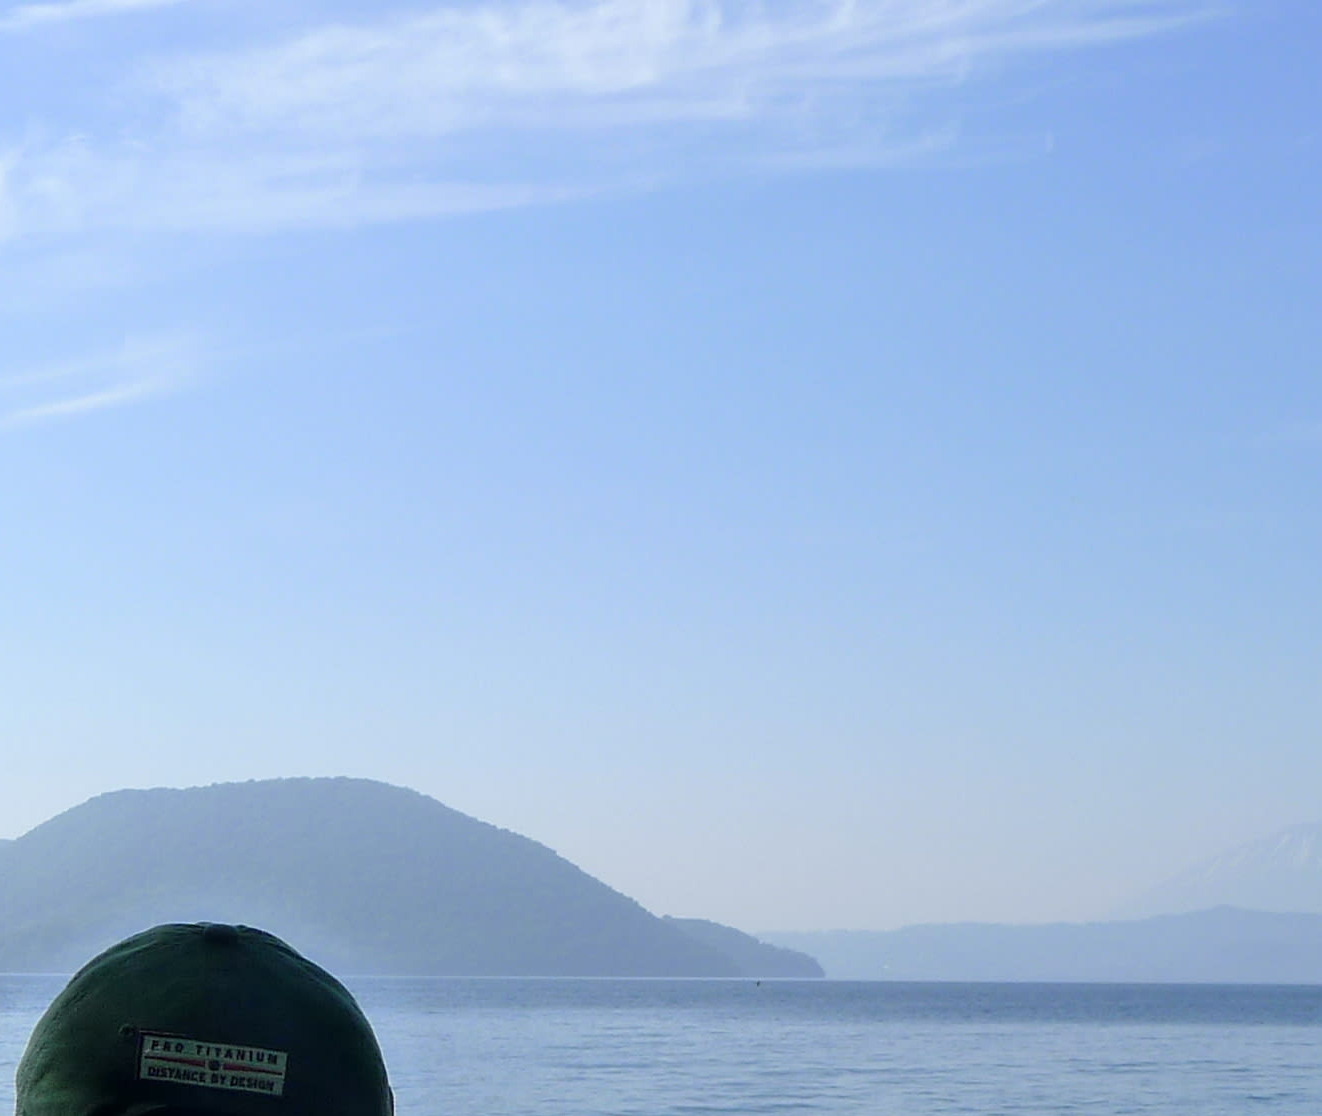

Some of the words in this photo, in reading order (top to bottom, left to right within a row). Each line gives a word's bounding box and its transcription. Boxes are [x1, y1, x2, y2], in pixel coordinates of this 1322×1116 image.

[151, 1039, 184, 1053] PRO
[196, 1044, 278, 1065] TITANIUM
[147, 1066, 206, 1083] DISTANCE
[211, 1073, 227, 1085] BY
[230, 1075, 275, 1092] DESIGN
